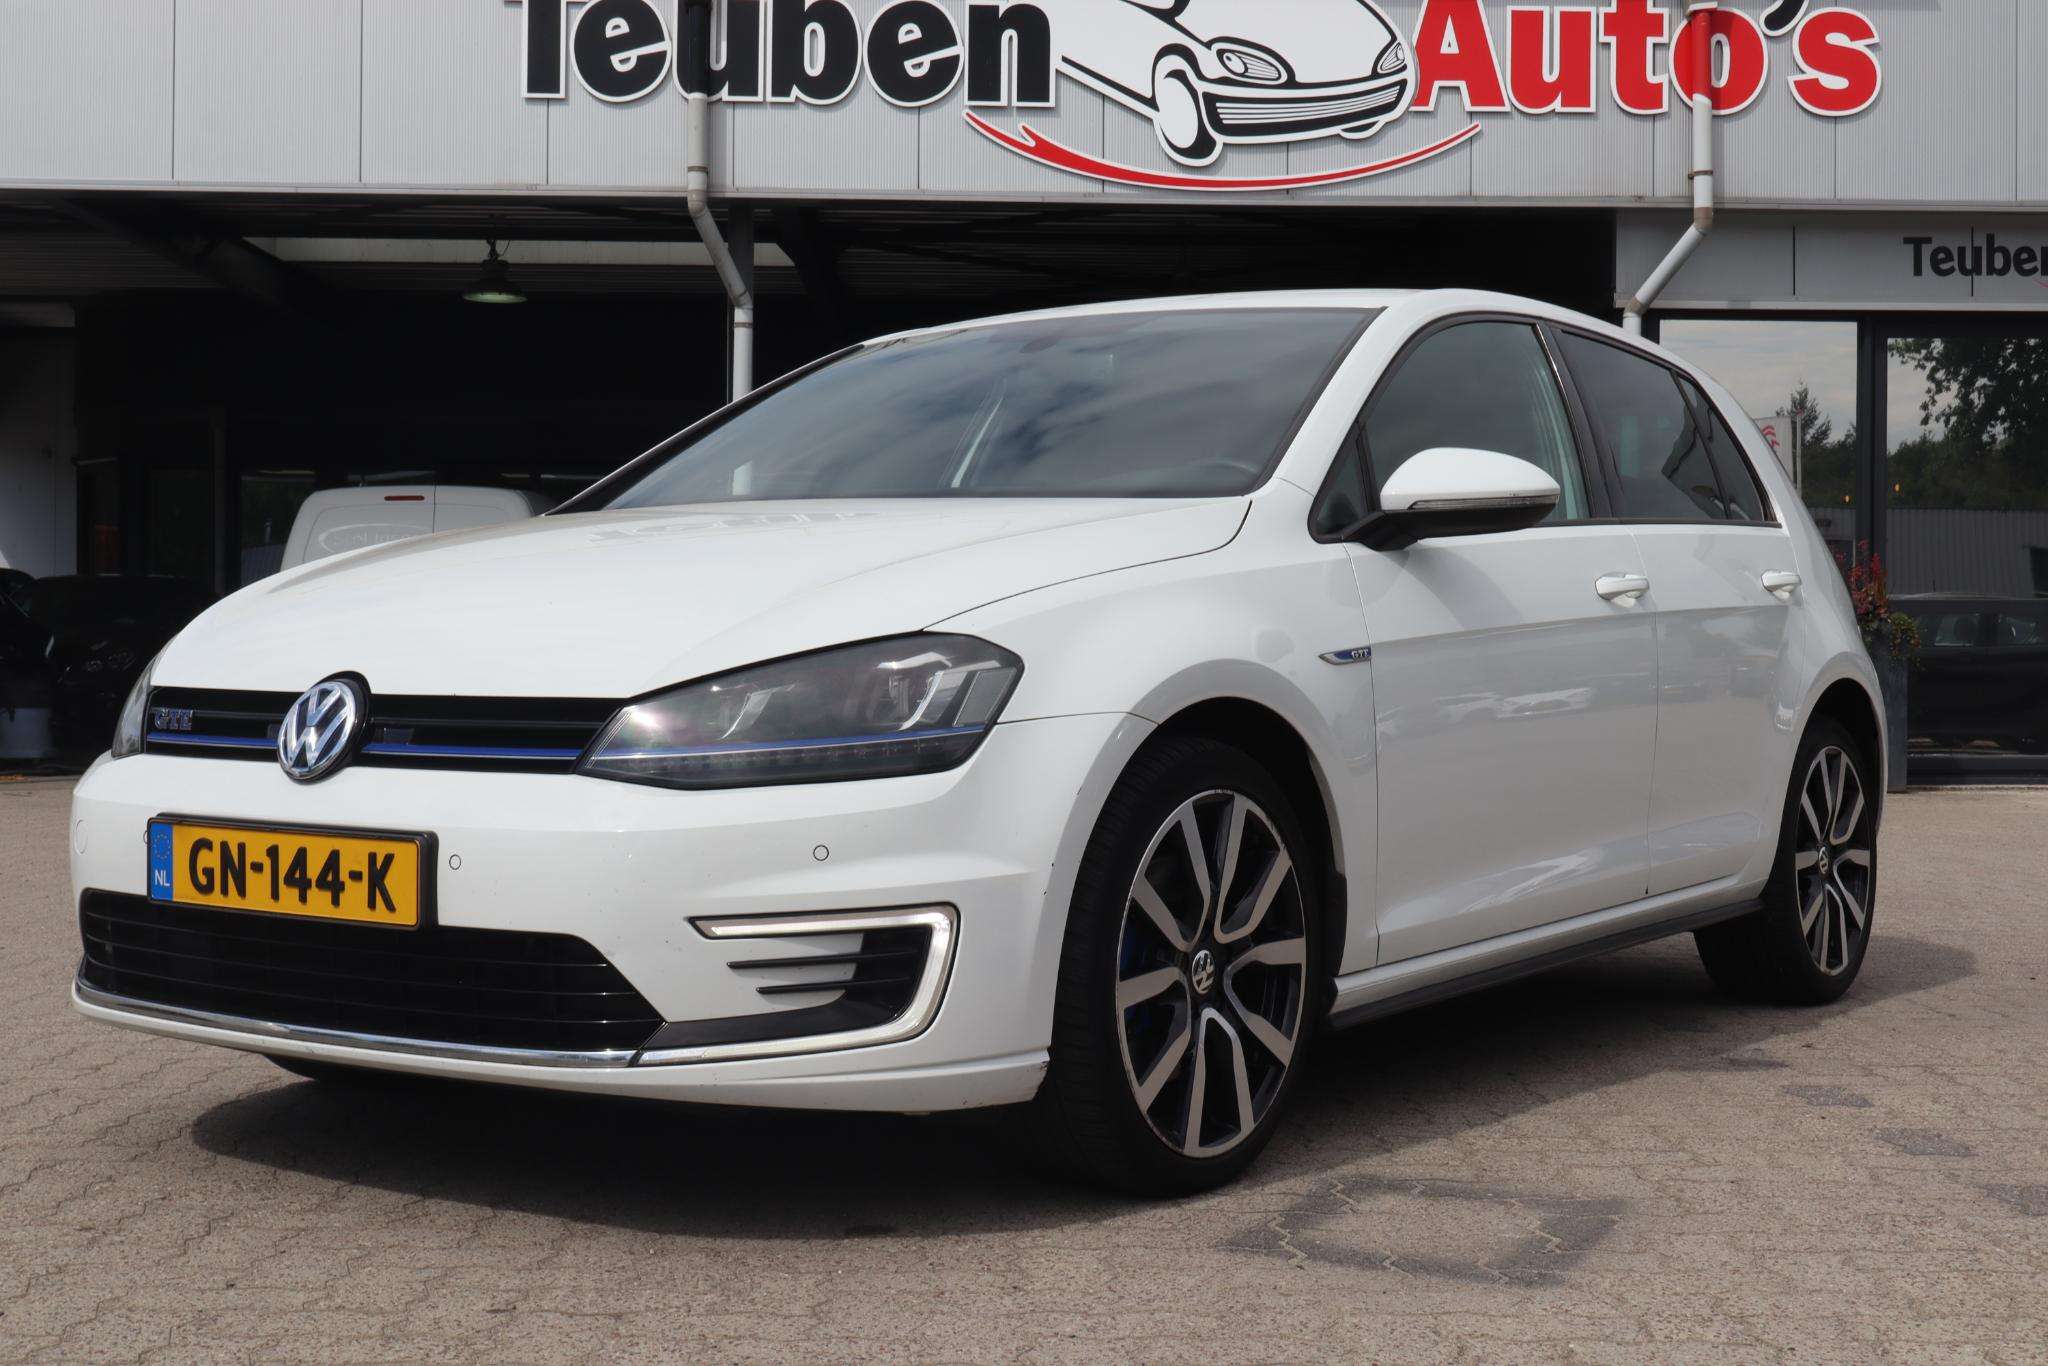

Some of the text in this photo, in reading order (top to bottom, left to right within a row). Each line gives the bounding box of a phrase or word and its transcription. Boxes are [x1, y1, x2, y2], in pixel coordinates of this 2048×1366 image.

[522, 0, 1879, 112] Teuben Auto's
[1902, 232, 2048, 277] Teube
[153, 707, 193, 730] GTE
[154, 869, 171, 887] NL
[188, 837, 397, 913] GN-144-K
